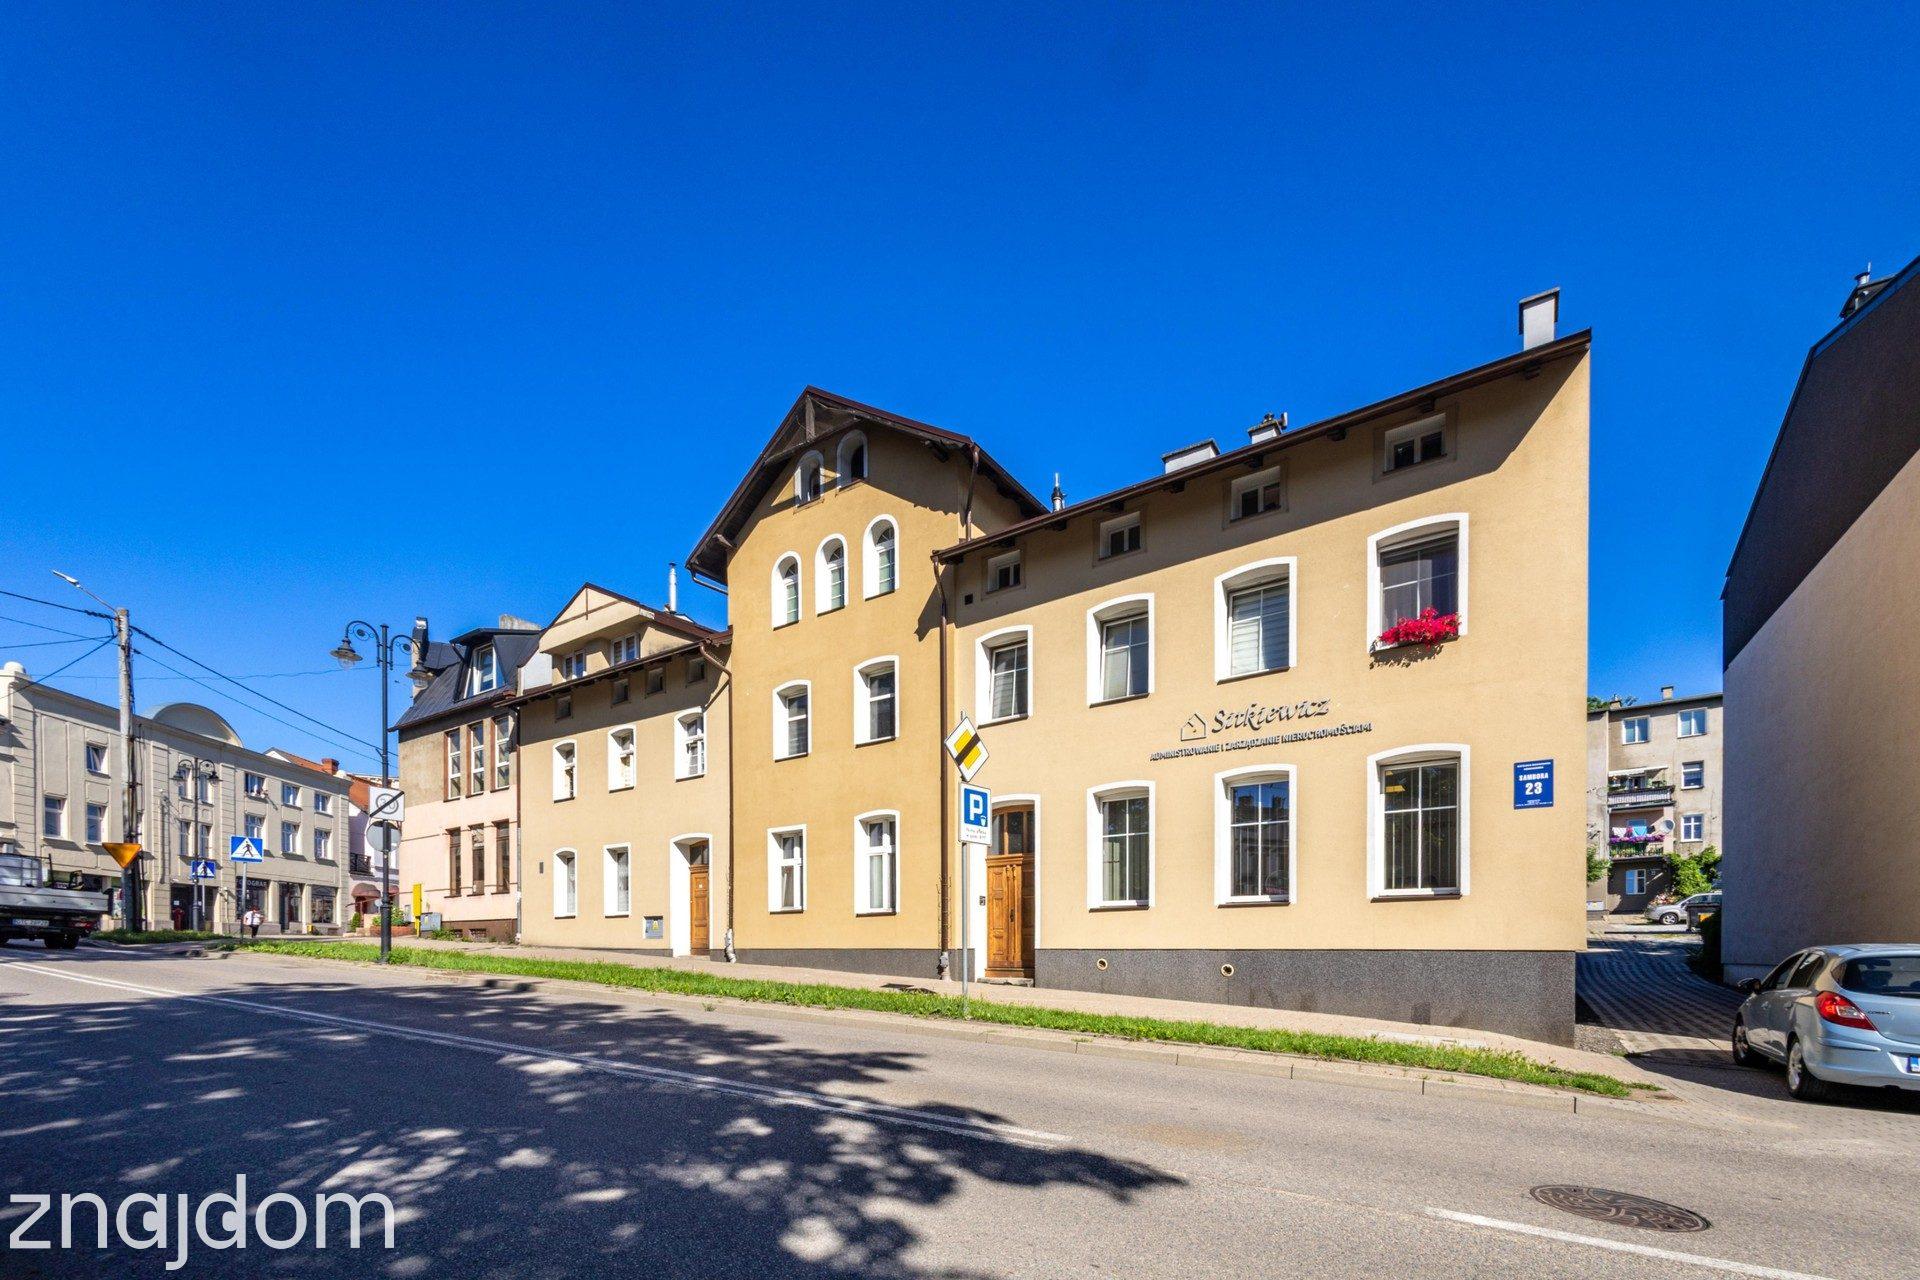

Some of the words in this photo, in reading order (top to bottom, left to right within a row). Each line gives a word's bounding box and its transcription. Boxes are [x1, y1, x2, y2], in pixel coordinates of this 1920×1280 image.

[1150, 744, 1219, 761] ADMINISTROWANIE
[1518, 772, 1549, 782] SAMBORA
[1525, 781, 1543, 796] 23
[969, 793, 984, 821] P
